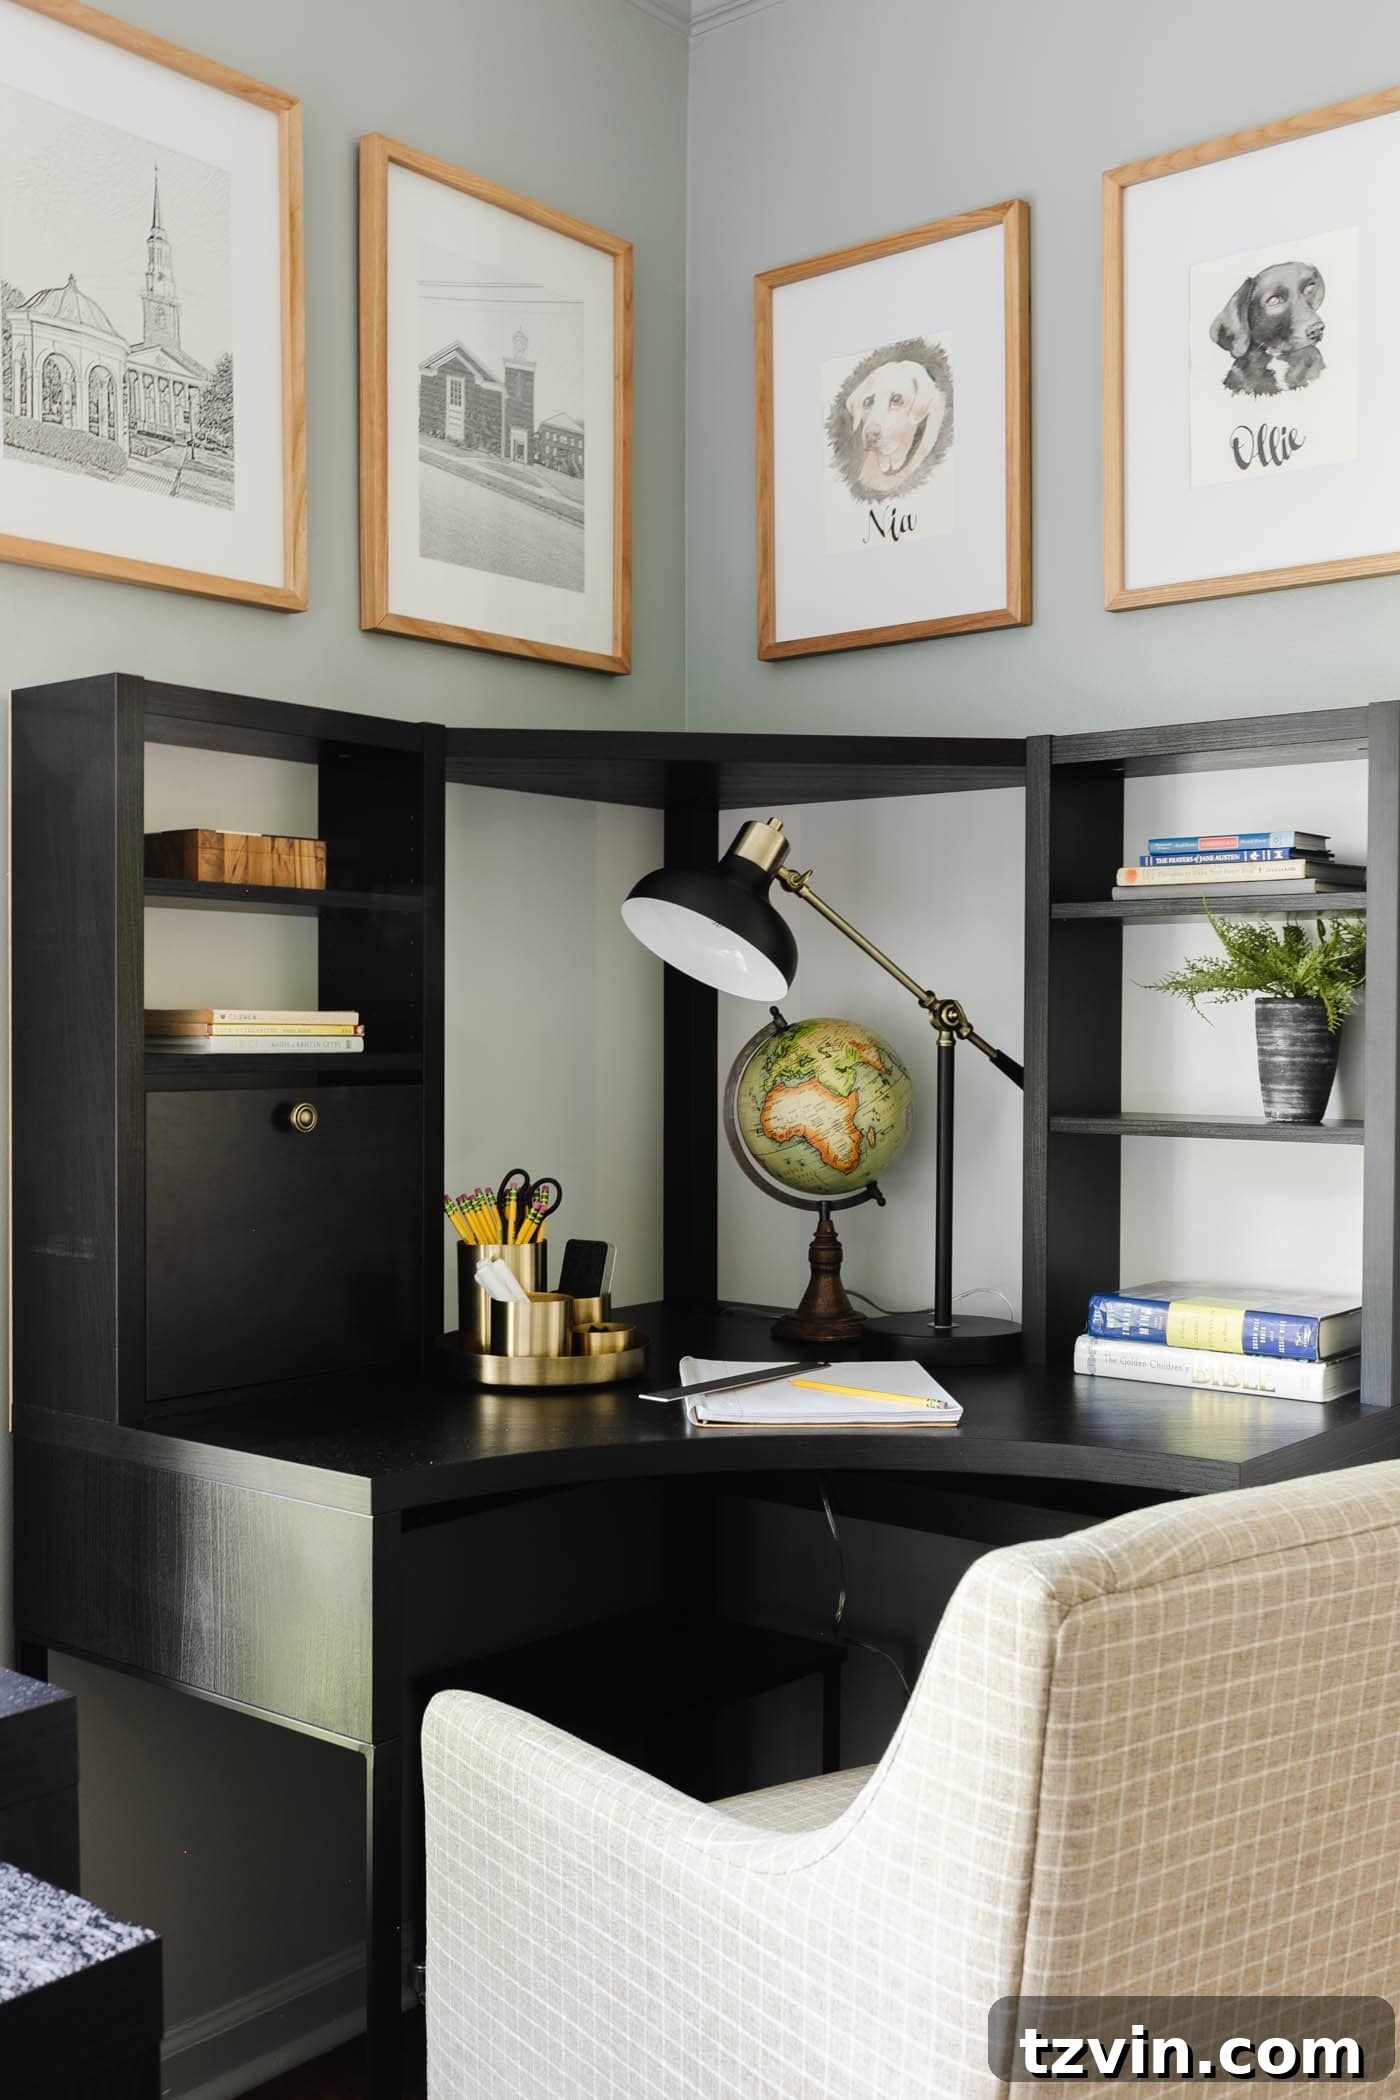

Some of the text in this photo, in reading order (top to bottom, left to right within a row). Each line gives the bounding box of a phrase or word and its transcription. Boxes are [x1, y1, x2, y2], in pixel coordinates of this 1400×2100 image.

[1230, 423, 1306, 470] Ollie
[862, 505, 918, 544] Nia
[1104, 1353, 1118, 1366] The
[1192, 1355, 1276, 1393] BIBLE
